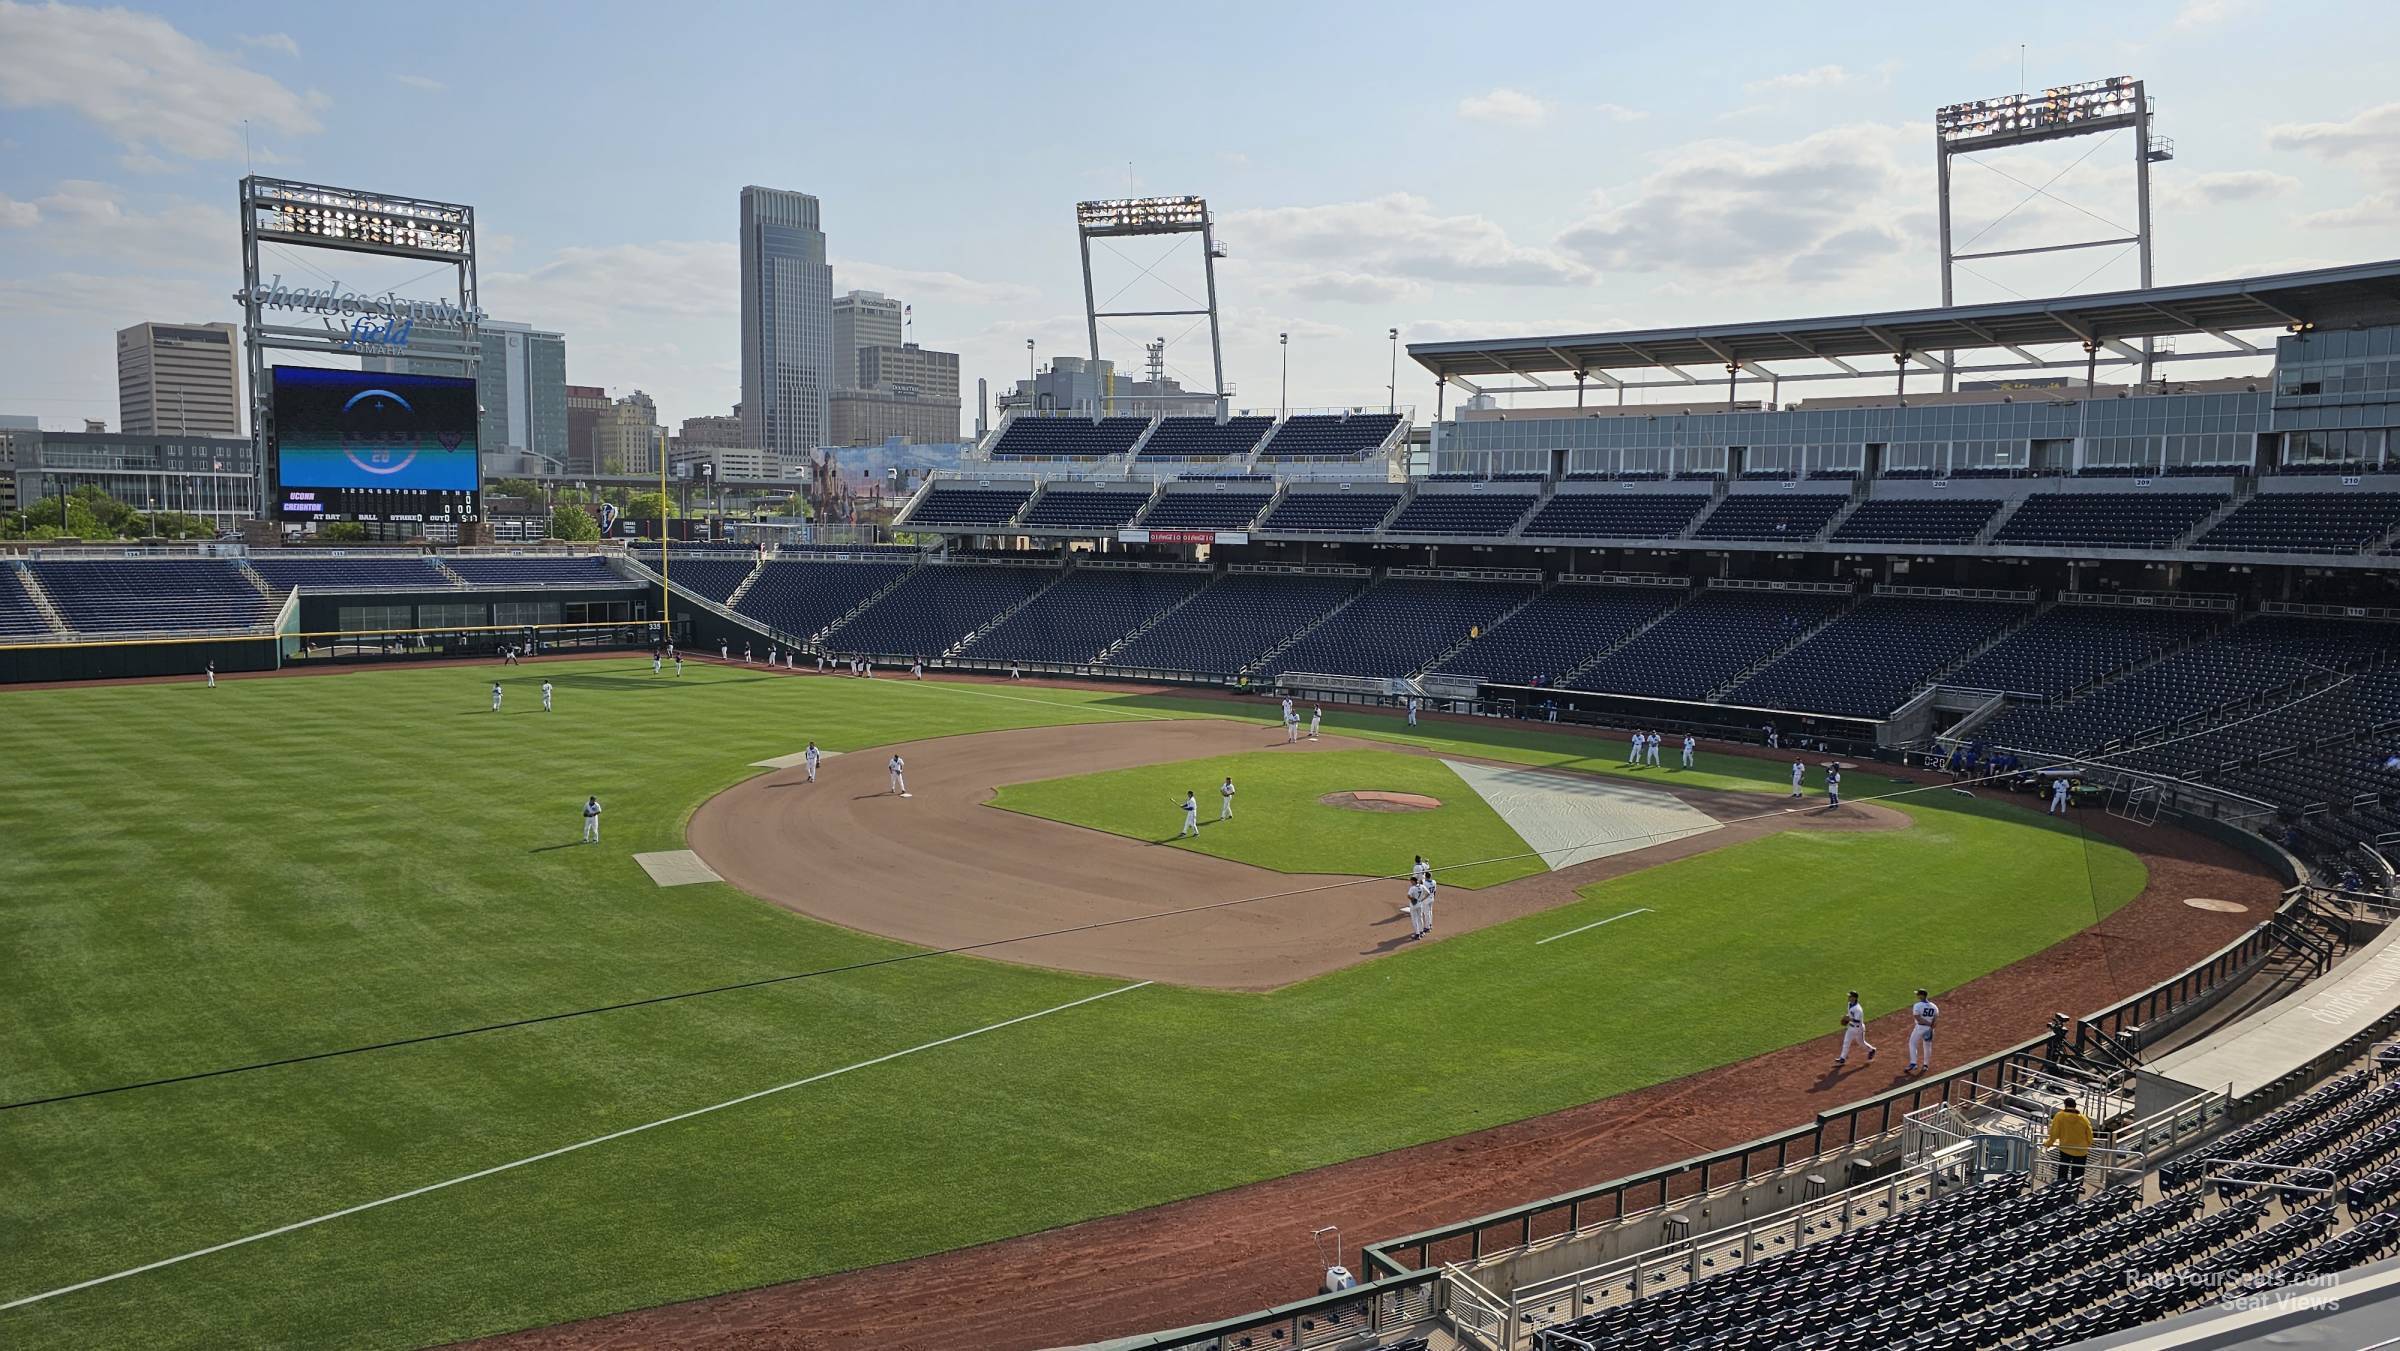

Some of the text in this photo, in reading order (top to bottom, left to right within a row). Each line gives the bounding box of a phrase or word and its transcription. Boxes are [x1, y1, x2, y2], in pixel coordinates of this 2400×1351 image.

[251, 274, 369, 314] charles
[342, 316, 413, 349] field
[355, 343, 405, 356] OMAHA
[290, 492, 472, 504] UCONN 0
[284, 503, 472, 514] CREIGHTON 0 0 0
[461, 514, 478, 522] 5:17
[1924, 756, 1945, 768] 0:20
[1922, 1008, 1935, 1017] 50
